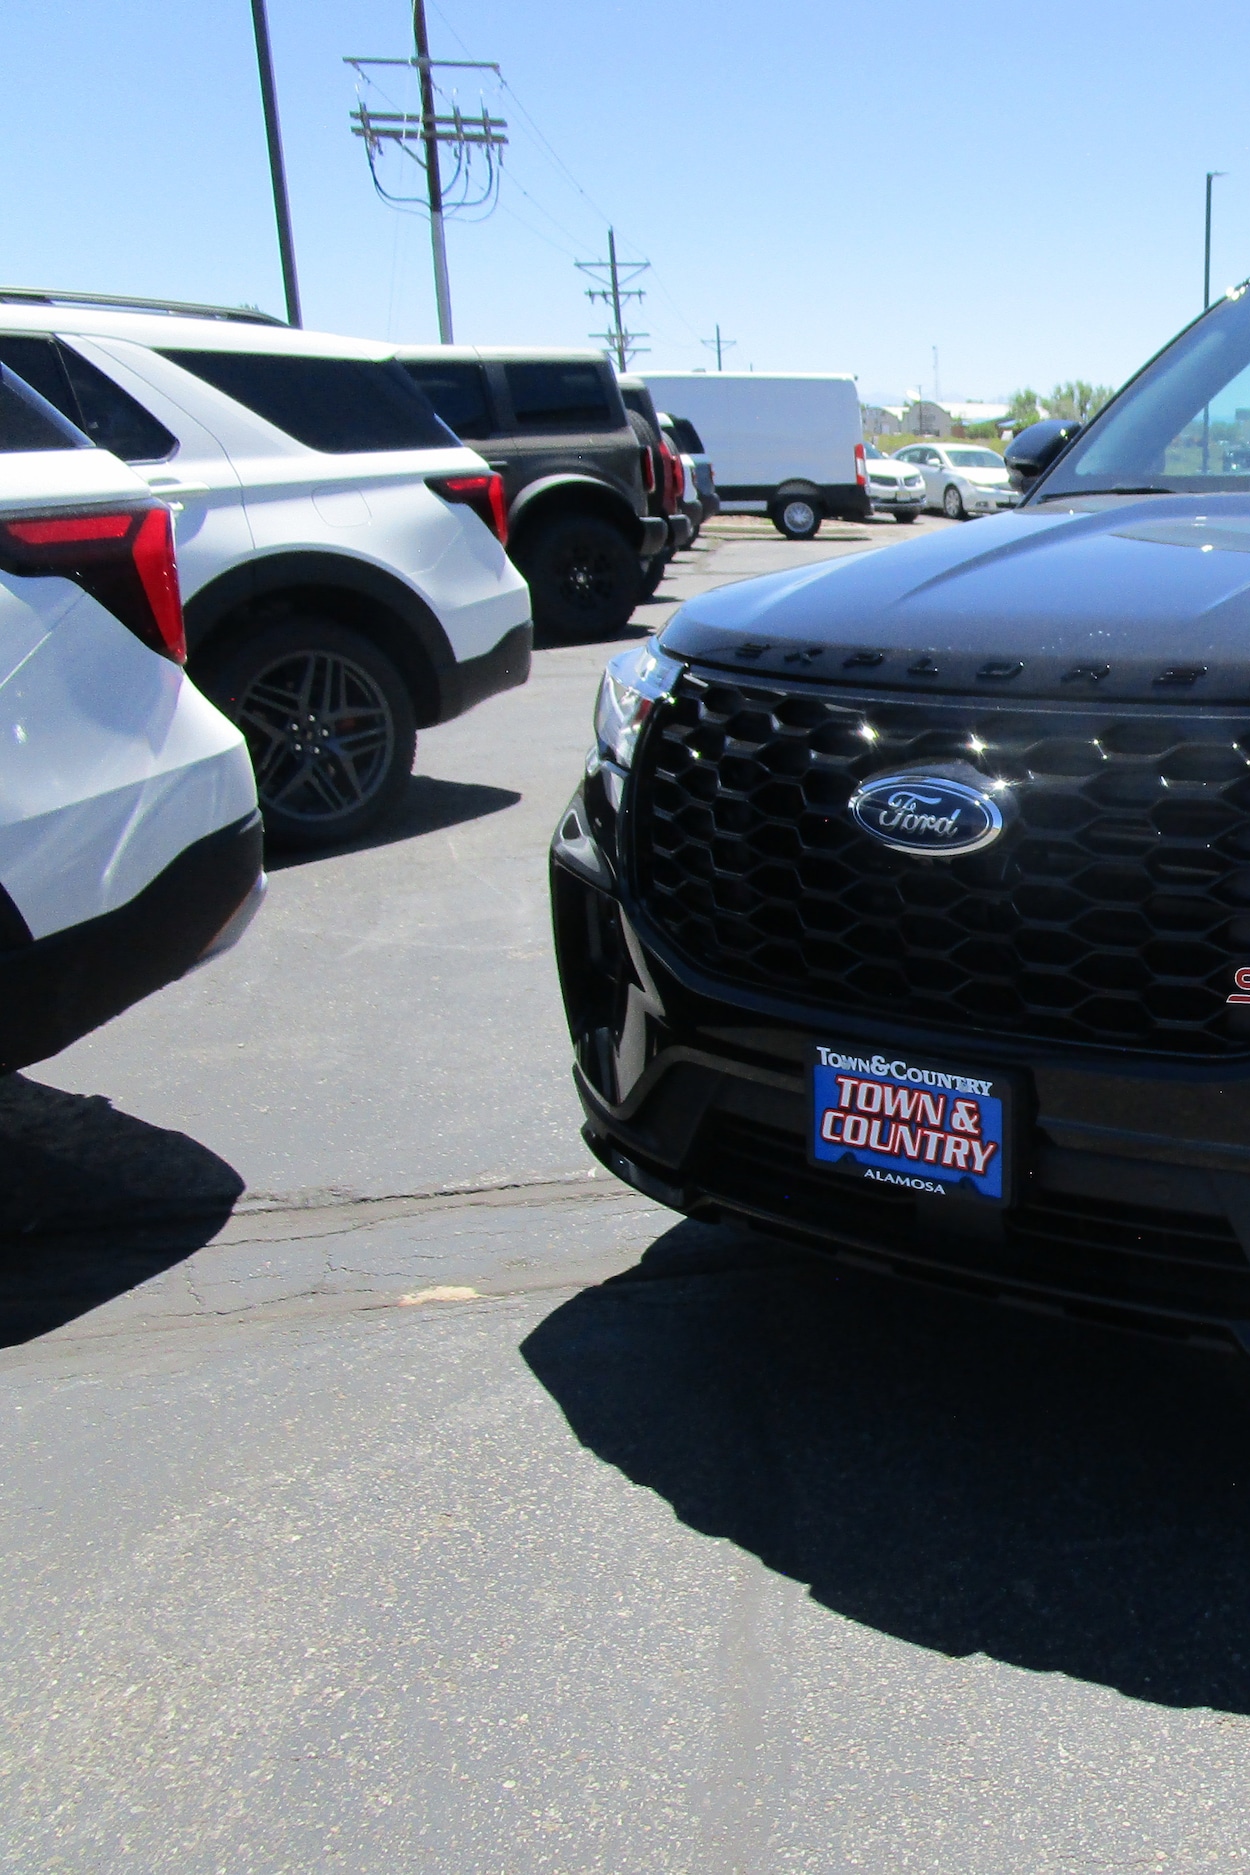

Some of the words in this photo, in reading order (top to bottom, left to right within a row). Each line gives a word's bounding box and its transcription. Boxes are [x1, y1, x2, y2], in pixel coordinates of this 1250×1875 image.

[879, 791, 962, 837] Ford
[836, 1075, 946, 1128] TOWN
[951, 1099, 981, 1135] &
[821, 1110, 998, 1174] COUNTRY
[864, 1168, 946, 1195] ALAMOSA
